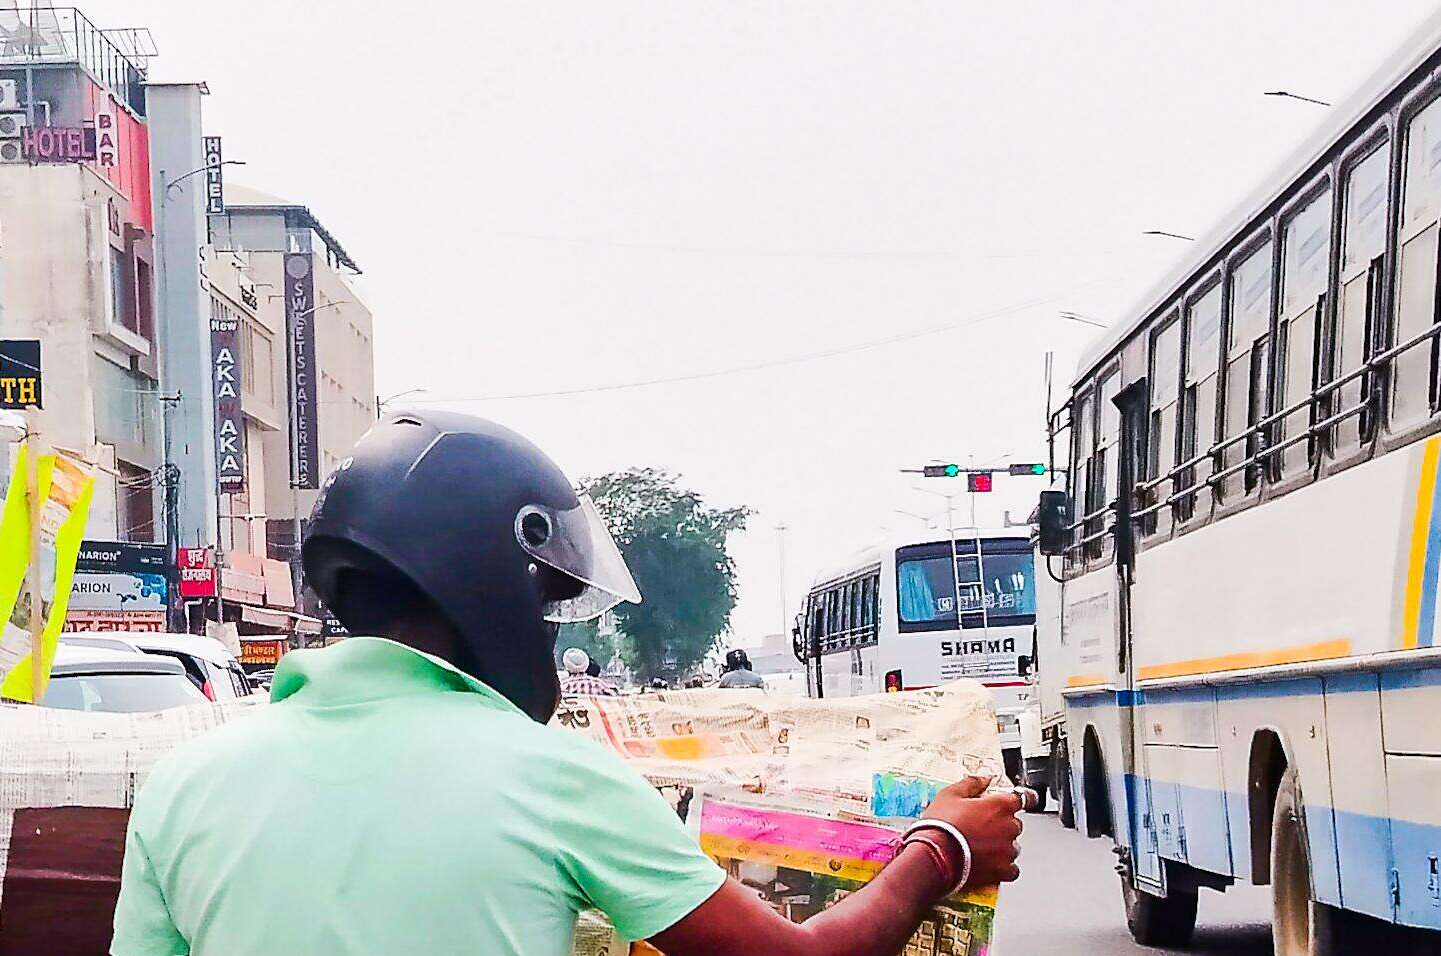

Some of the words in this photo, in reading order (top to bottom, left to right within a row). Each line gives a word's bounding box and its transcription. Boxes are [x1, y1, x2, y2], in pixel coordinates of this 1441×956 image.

[23, 127, 95, 158] HOTEL
[99, 114, 114, 166] BAR
[207, 138, 222, 213] HOTEL
[940, 637, 1015, 656] SHAMA
